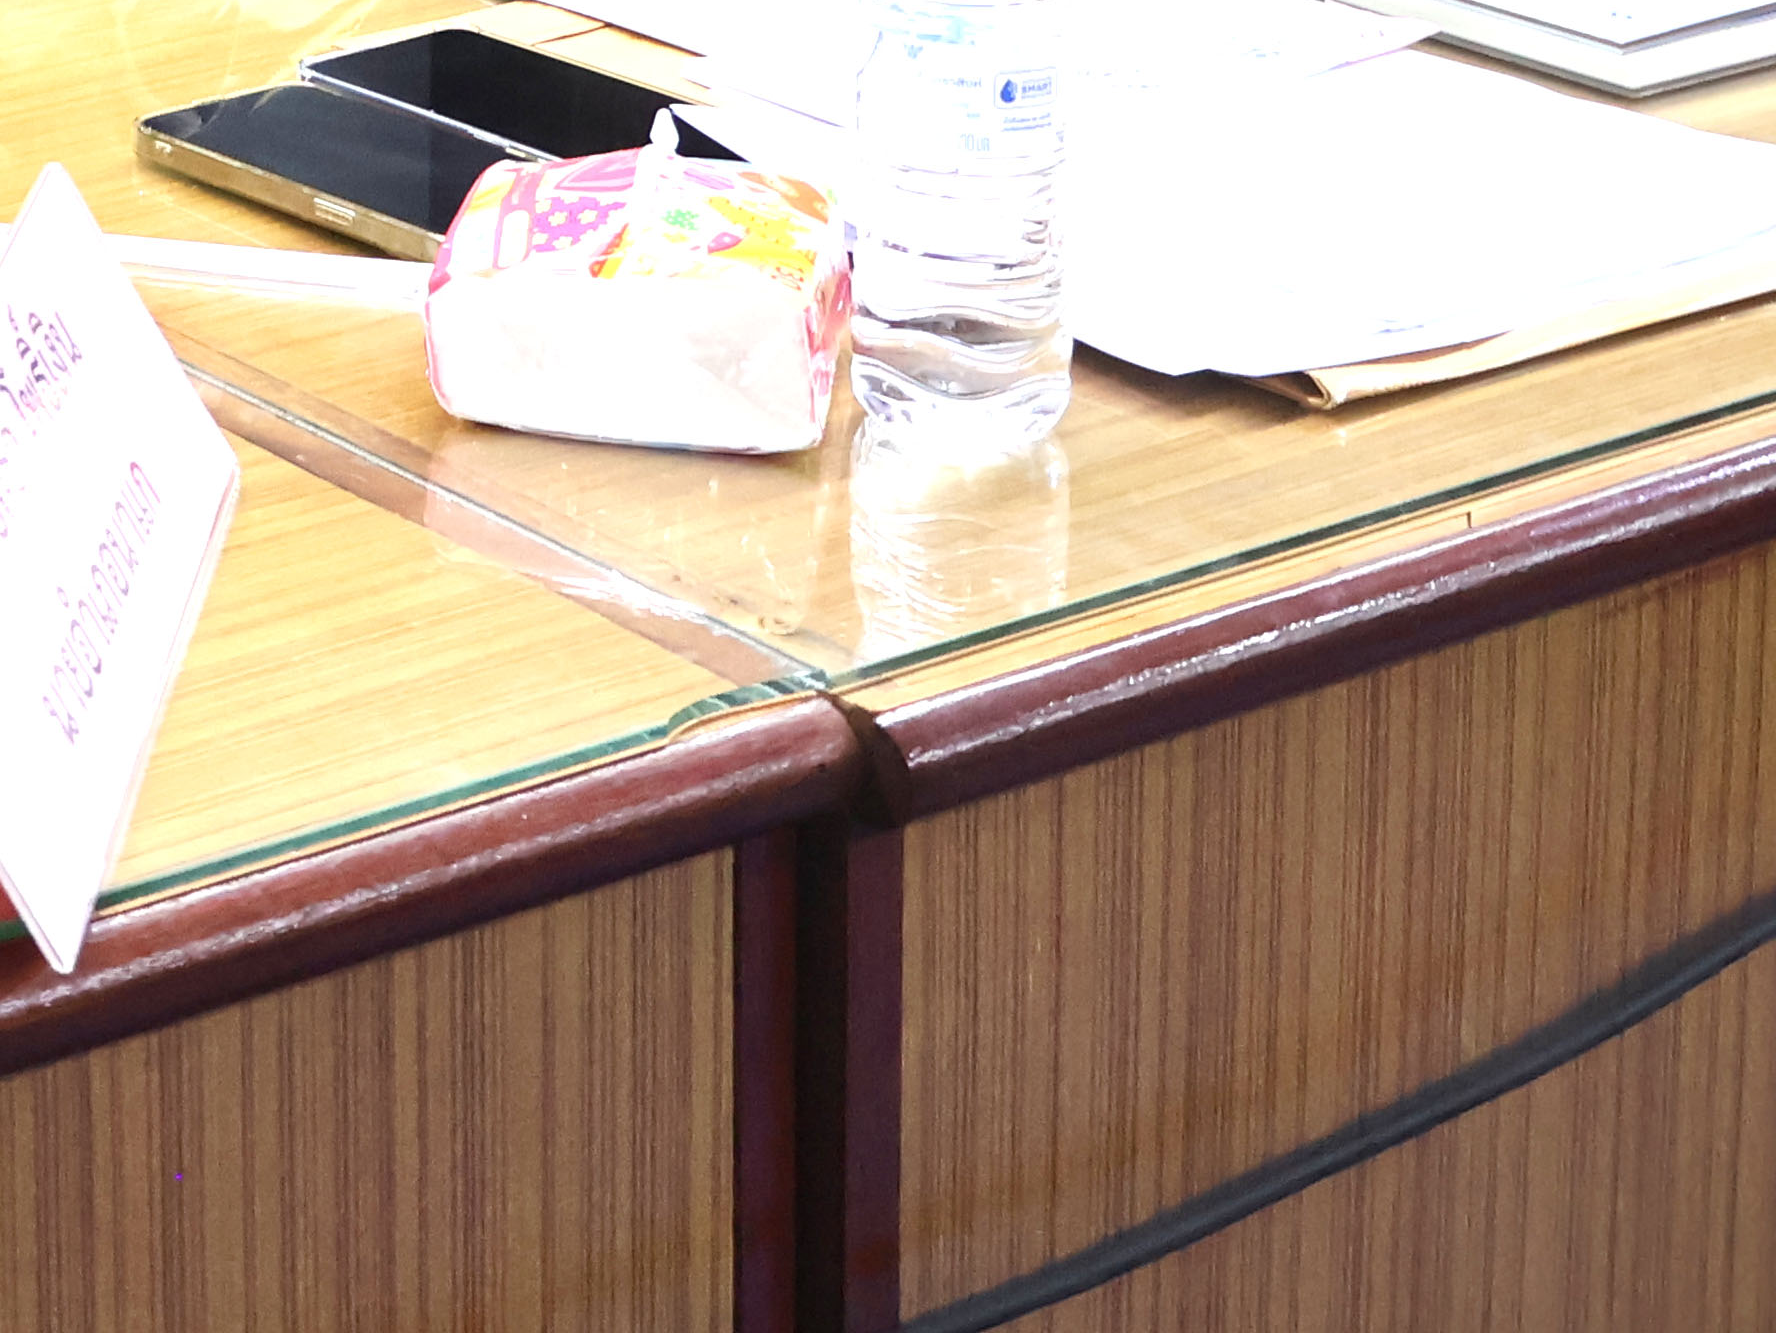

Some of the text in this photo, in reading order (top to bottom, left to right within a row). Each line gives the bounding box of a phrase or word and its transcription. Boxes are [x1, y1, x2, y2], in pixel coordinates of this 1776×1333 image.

[42, 461, 161, 745] นายอำเภอนาแก
